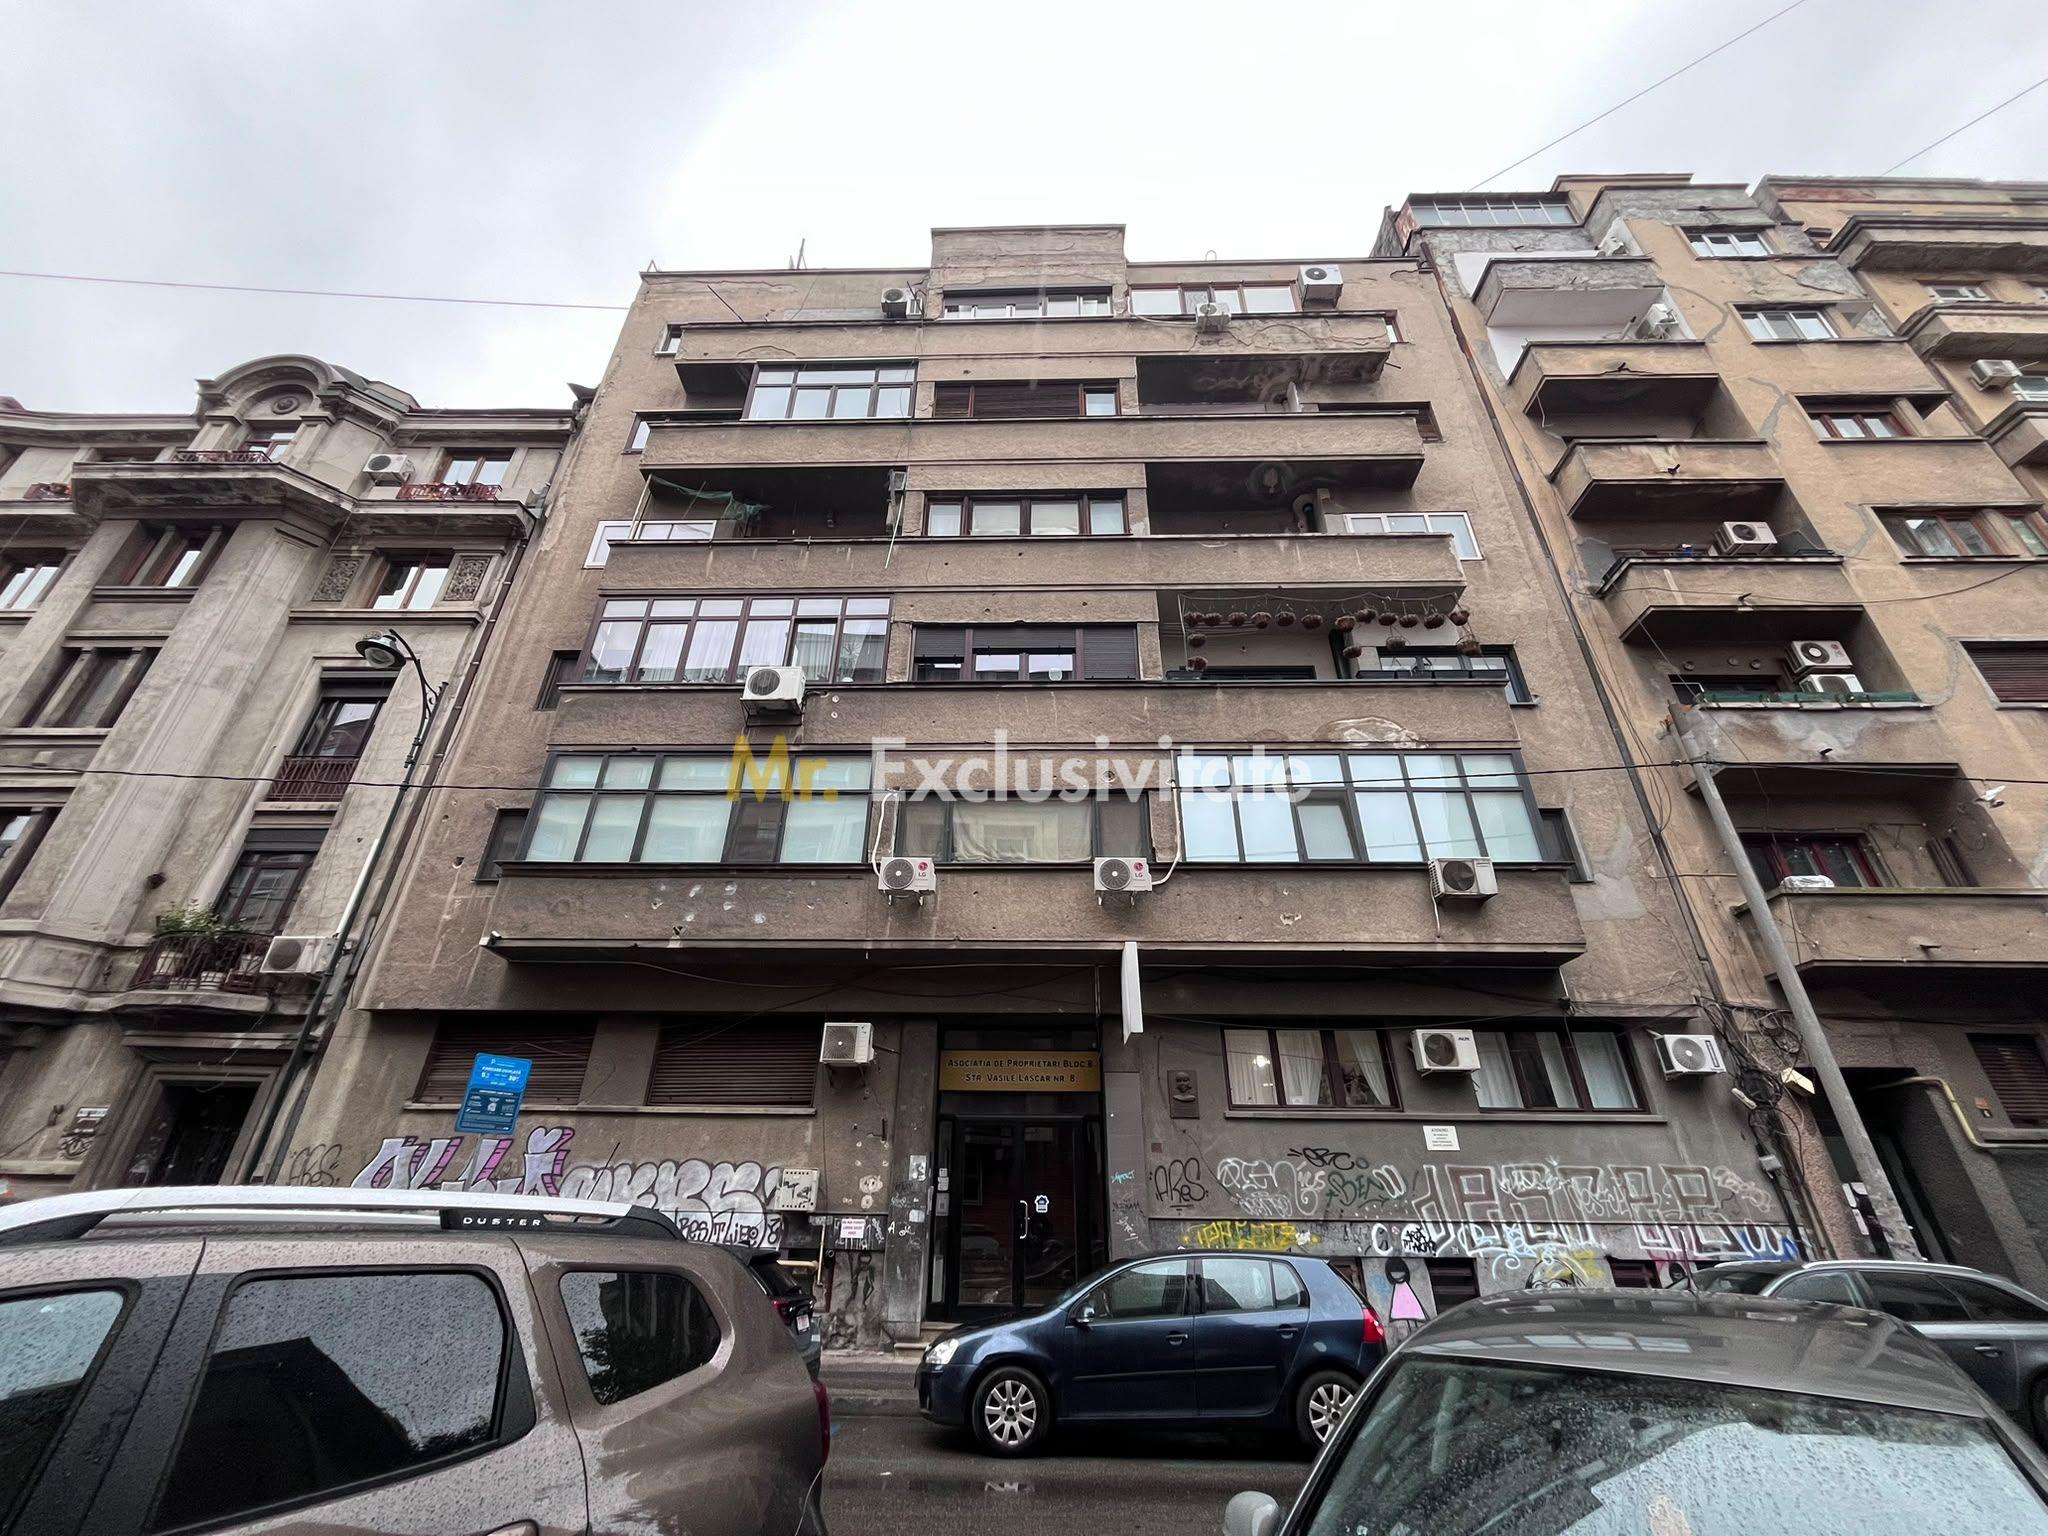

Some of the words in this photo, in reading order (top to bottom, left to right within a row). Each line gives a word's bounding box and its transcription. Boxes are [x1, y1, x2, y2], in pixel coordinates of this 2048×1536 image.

[1063, 1060, 1085, 1068] BLOC
[987, 1074, 1016, 1082] VASILE
[1018, 1074, 1051, 1082] LASCAR
[463, 1217, 541, 1226] DUSTER
